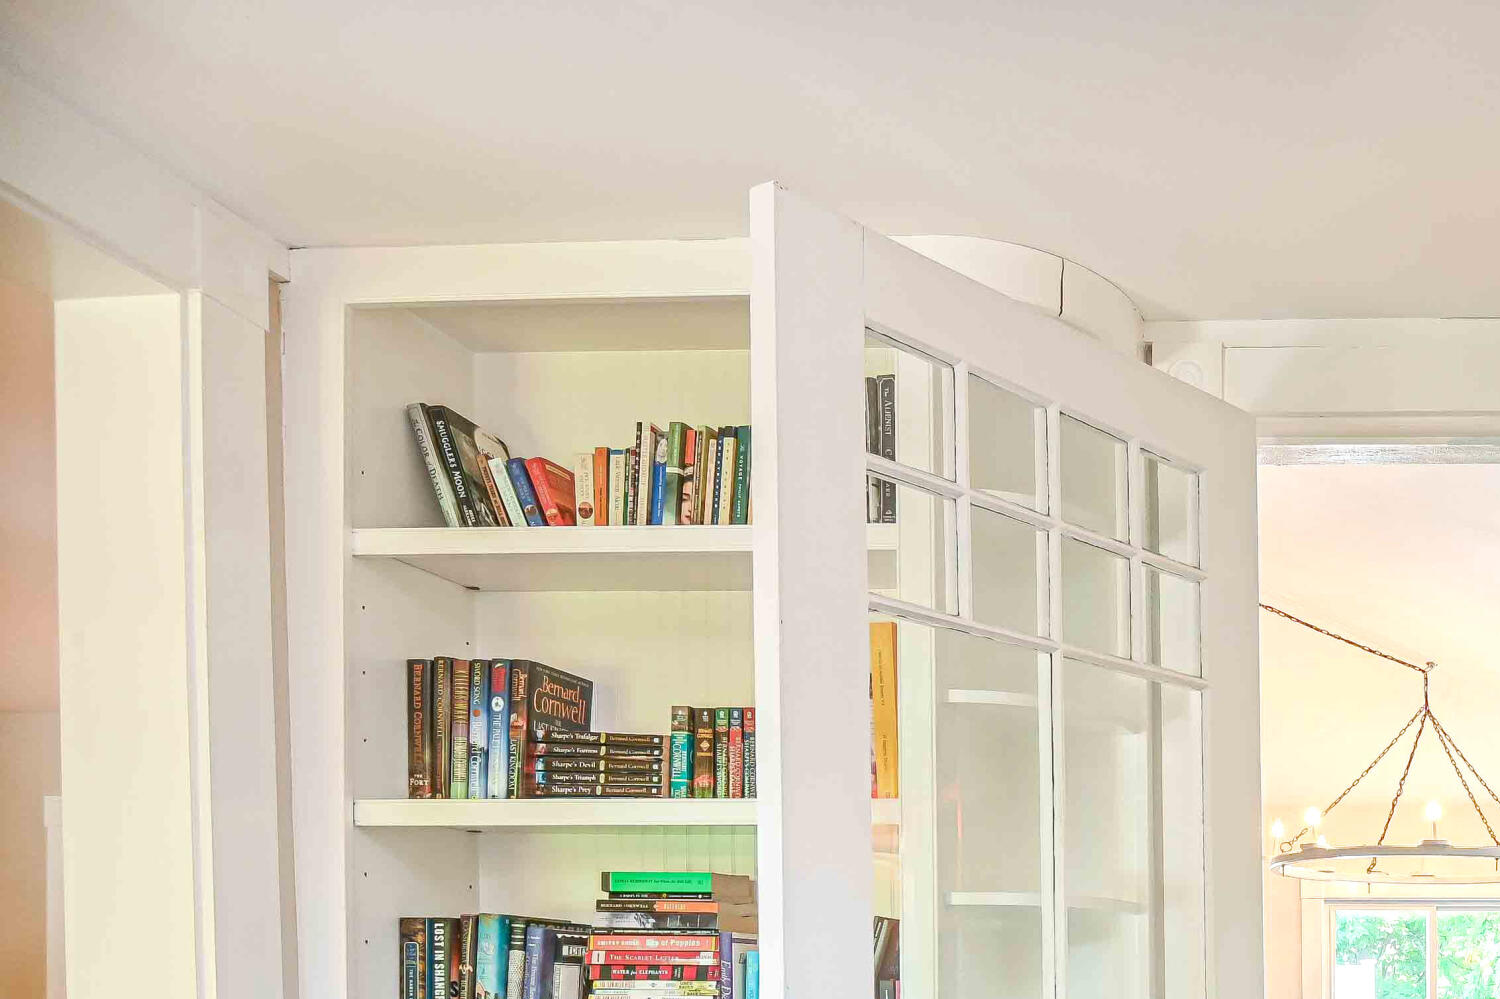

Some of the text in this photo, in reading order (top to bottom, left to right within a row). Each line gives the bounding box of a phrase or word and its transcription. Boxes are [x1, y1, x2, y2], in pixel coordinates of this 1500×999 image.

[884, 400, 892, 435] ALIENIST
[415, 428, 444, 501] COLOR DEATH
[435, 420, 466, 498] SMUGGLER'S MOON
[511, 669, 521, 701] Cornwell
[519, 673, 527, 698] Bernard
[542, 675, 580, 703] Bernard
[413, 664, 422, 764] BERNARD CORNWELL
[534, 688, 586, 726] Cornwell
[472, 721, 482, 754] Bernard
[551, 732, 598, 741] Sharpe's Trafalgar
[508, 739, 517, 790] LAST KINGDOM
[673, 744, 681, 778] CORNWELL
[578, 786, 592, 794] Prey
[434, 923, 444, 948] LOST
[435, 950, 445, 961] IN
